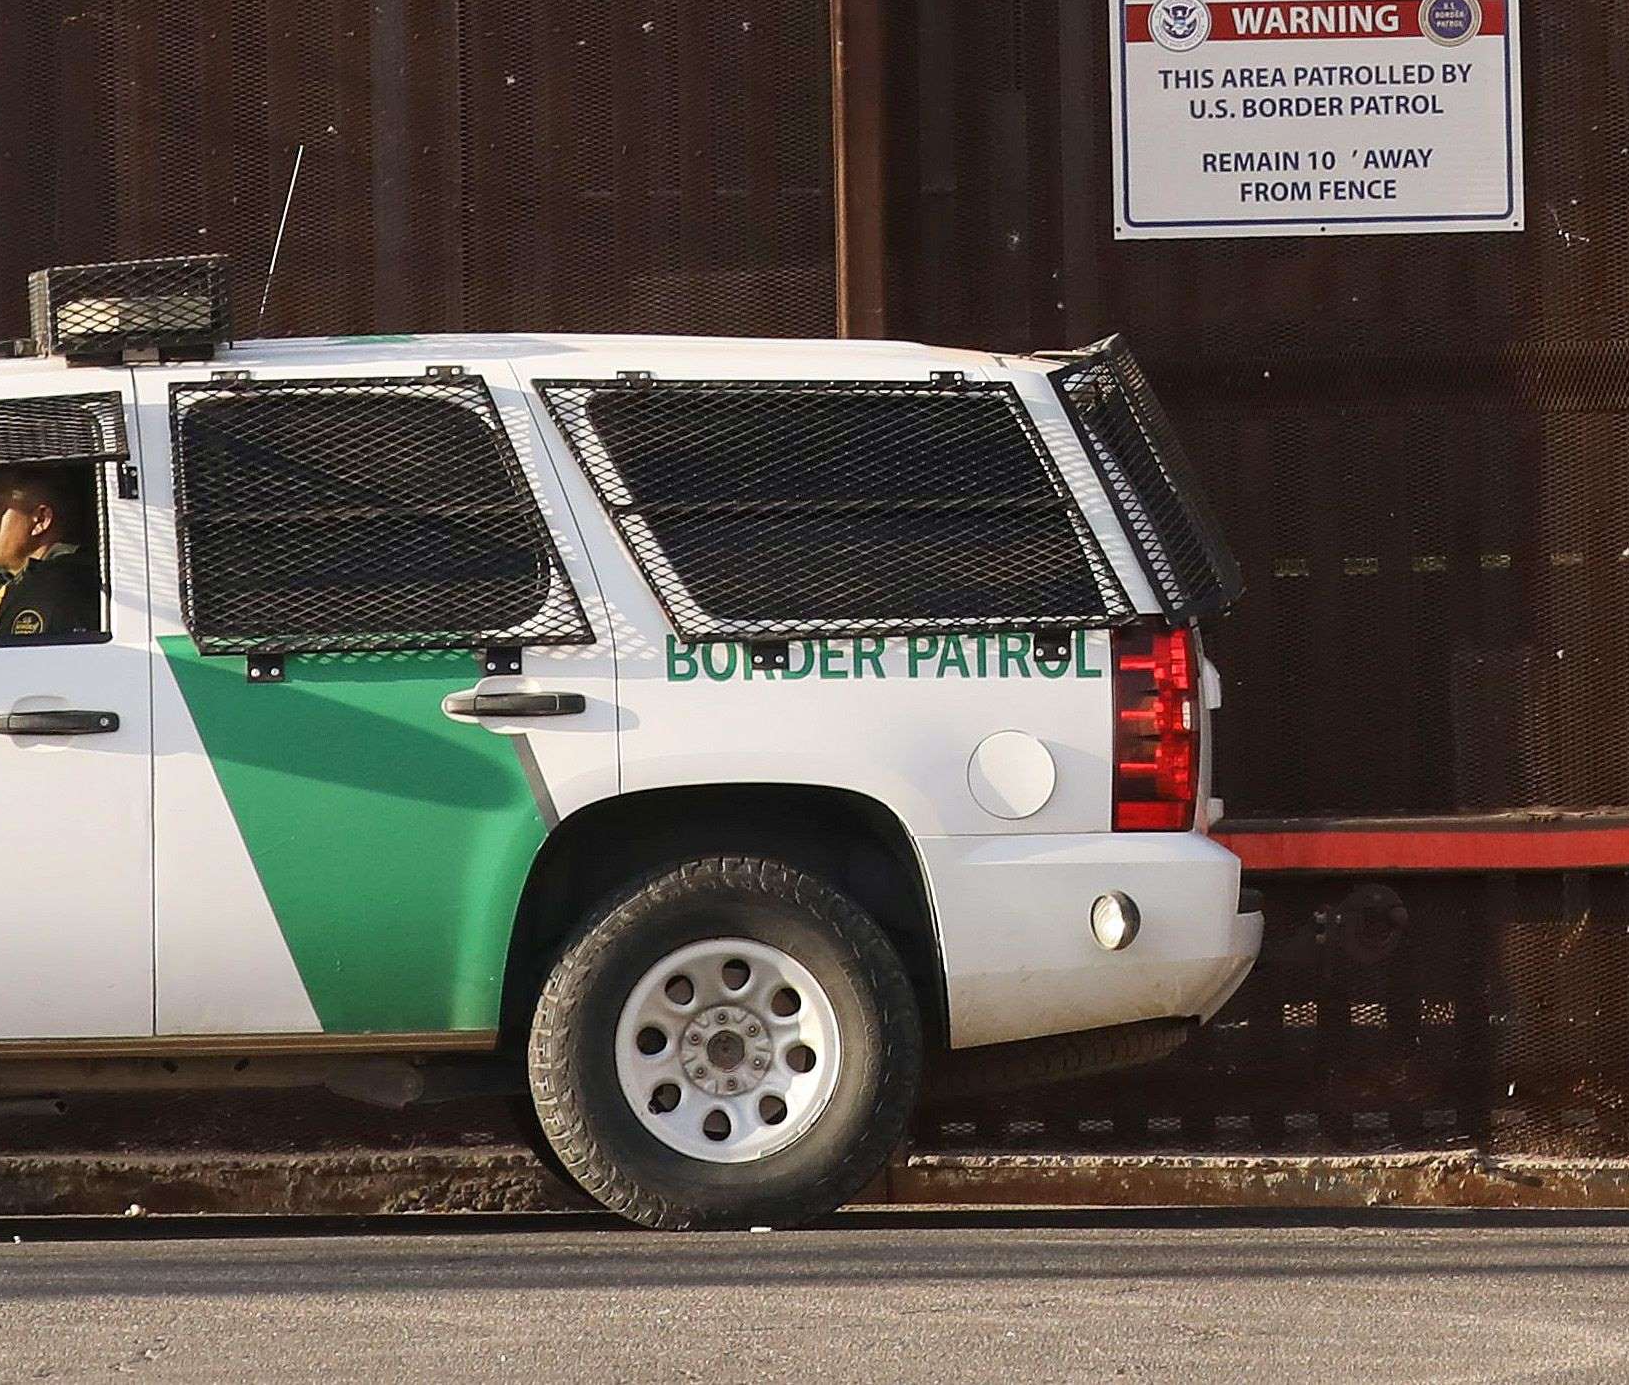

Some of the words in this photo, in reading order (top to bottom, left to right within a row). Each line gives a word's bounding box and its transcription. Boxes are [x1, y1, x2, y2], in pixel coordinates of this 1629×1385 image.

[1231, 4, 1399, 35] WARNING
[1158, 68, 1214, 89] THIS
[1221, 67, 1287, 88] AREA
[1294, 64, 1435, 87] PATROLLED
[1442, 63, 1473, 84] BY
[1190, 98, 1236, 119] U.S.
[1242, 96, 1343, 118] BORDER
[1350, 94, 1444, 116] PATROL
[1202, 150, 1300, 173] REMAIN
[1240, 181, 1312, 203] FROM
[1319, 179, 1397, 201] FENCE
